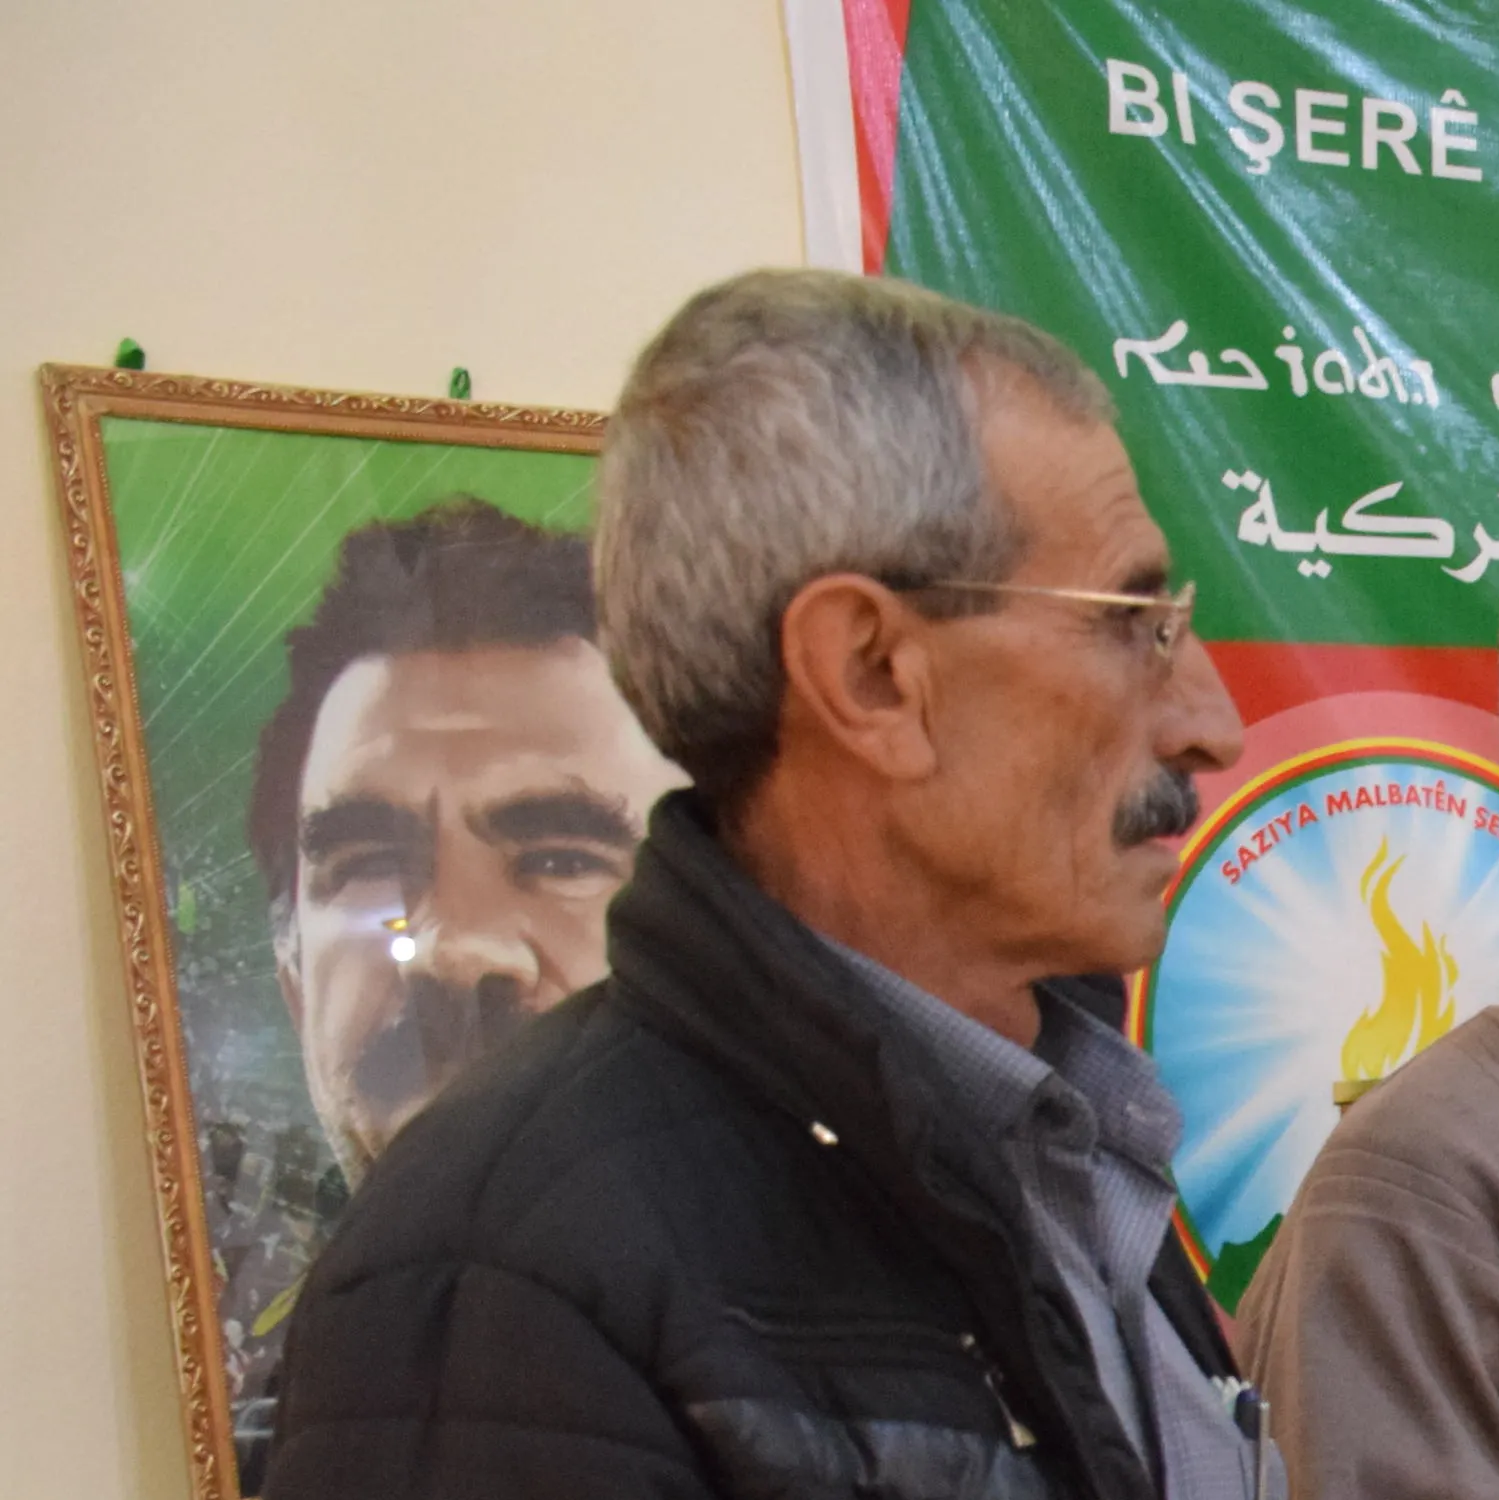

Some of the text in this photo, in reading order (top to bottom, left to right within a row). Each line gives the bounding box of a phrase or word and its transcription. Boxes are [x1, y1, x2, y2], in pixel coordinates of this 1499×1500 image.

[1105, 57, 1196, 145] BI
[1227, 80, 1483, 182] ŞERÊ
[1221, 803, 1319, 885] SAZIYA
[1326, 779, 1467, 818] MALBATÊN
